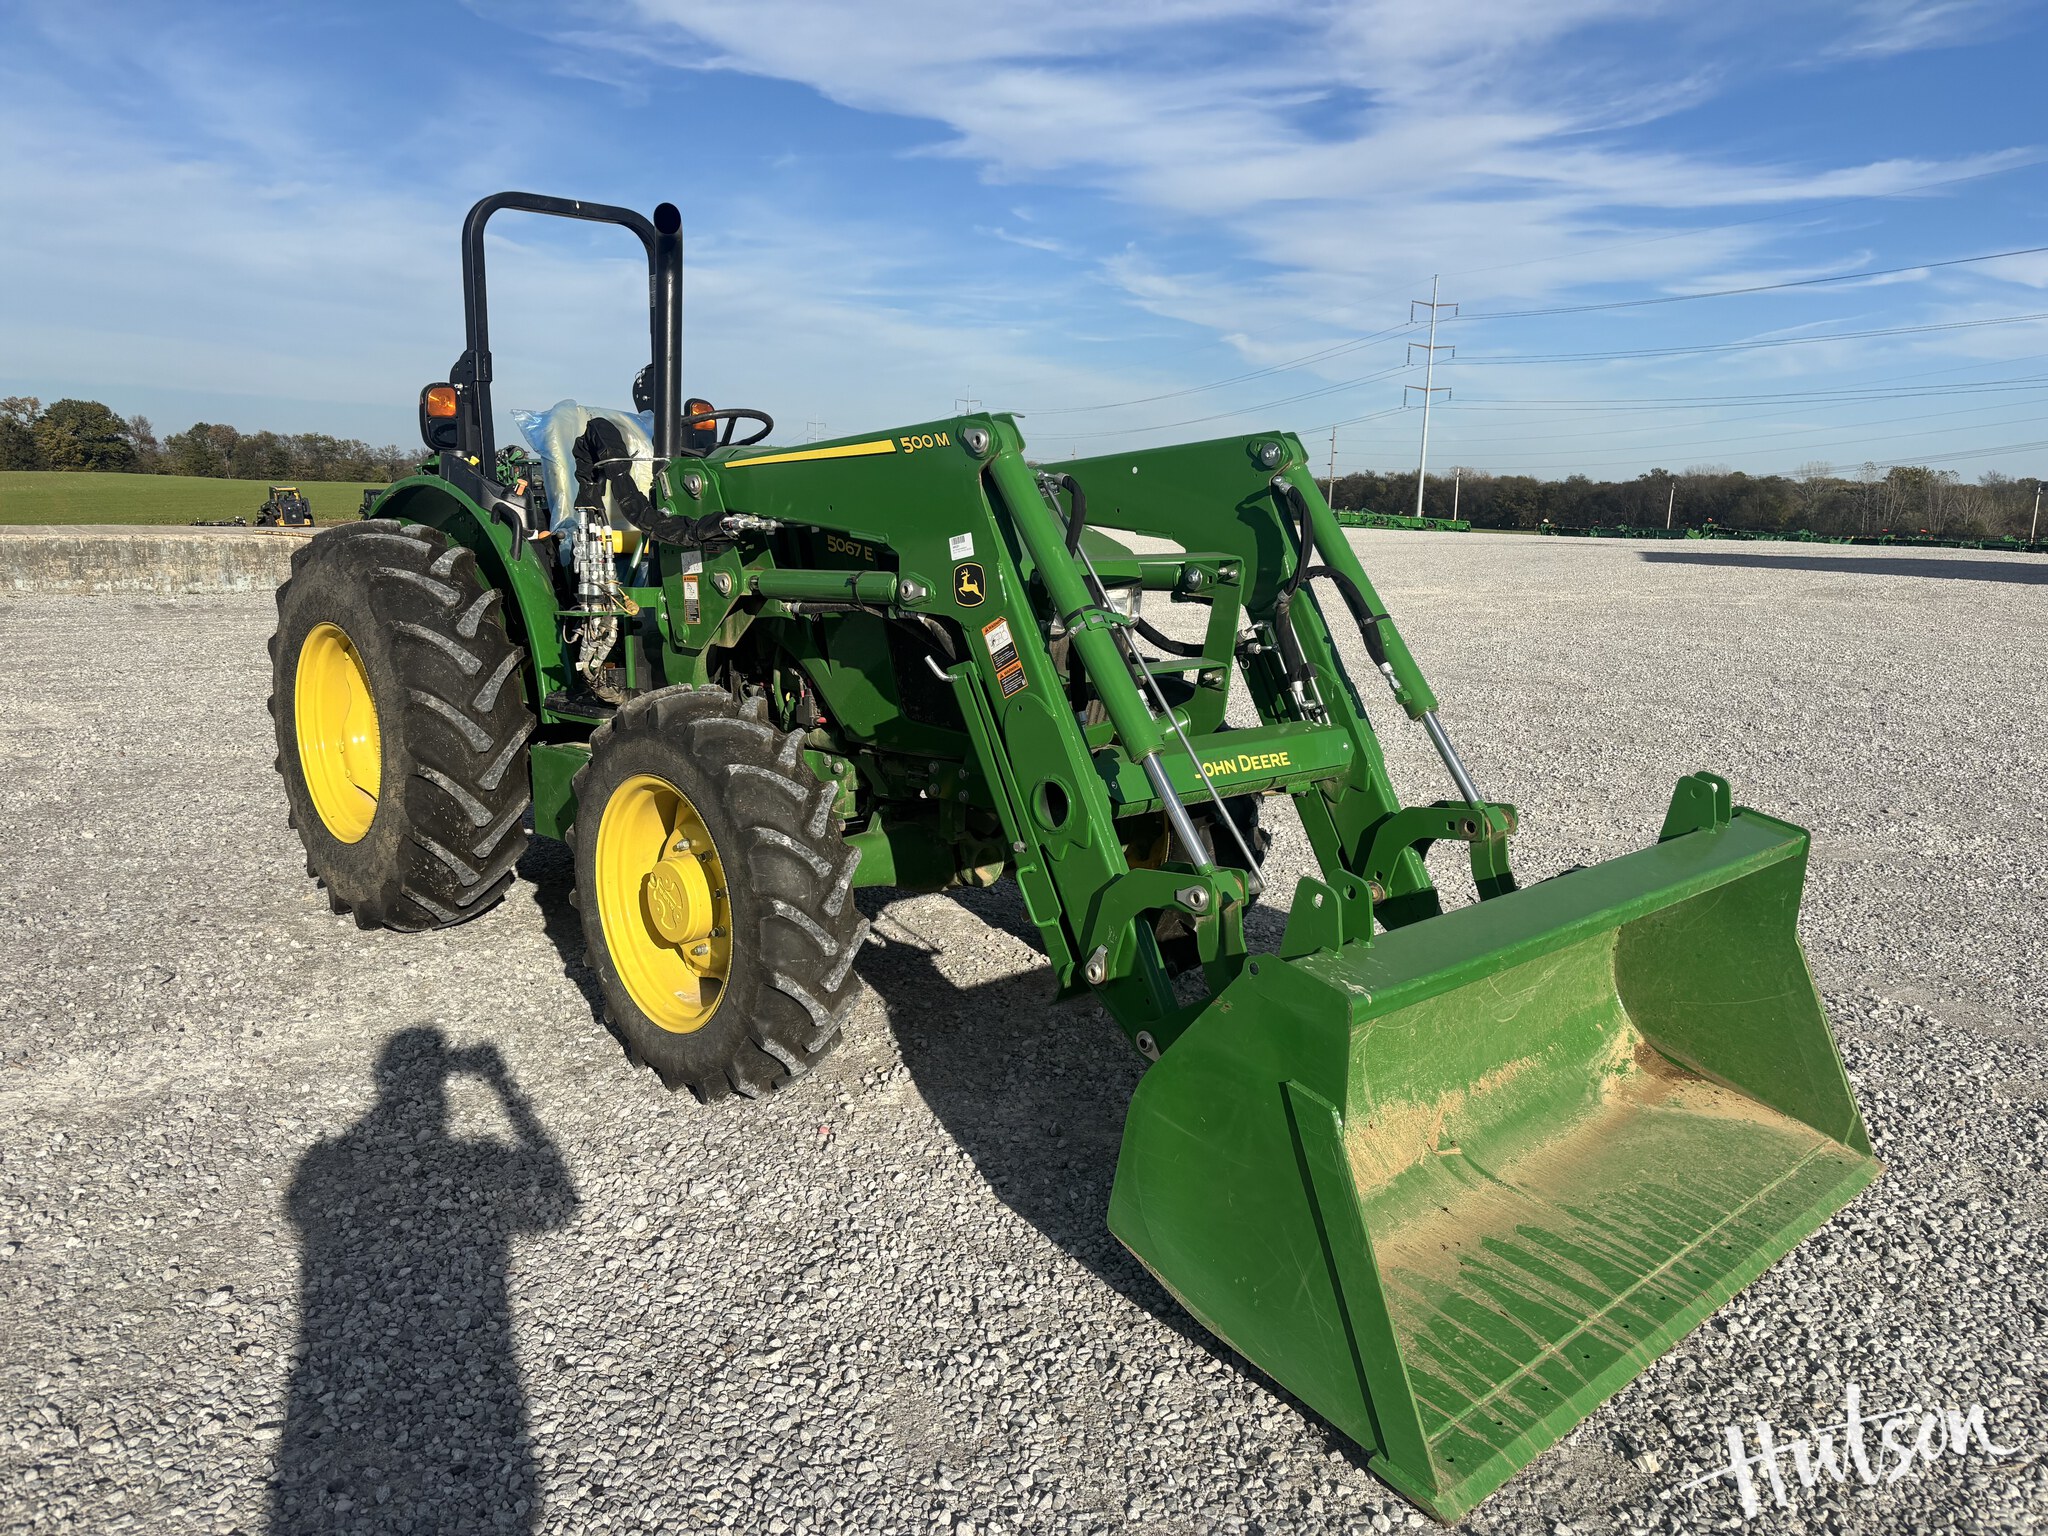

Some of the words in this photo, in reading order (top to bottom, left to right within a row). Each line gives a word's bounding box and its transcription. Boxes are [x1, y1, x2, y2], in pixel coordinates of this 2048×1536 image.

[900, 434, 933, 453] 500
[934, 432, 950, 447] M
[827, 535, 861, 557] 5067
[864, 548, 873, 561] E
[1238, 752, 1291, 772] DEERE
